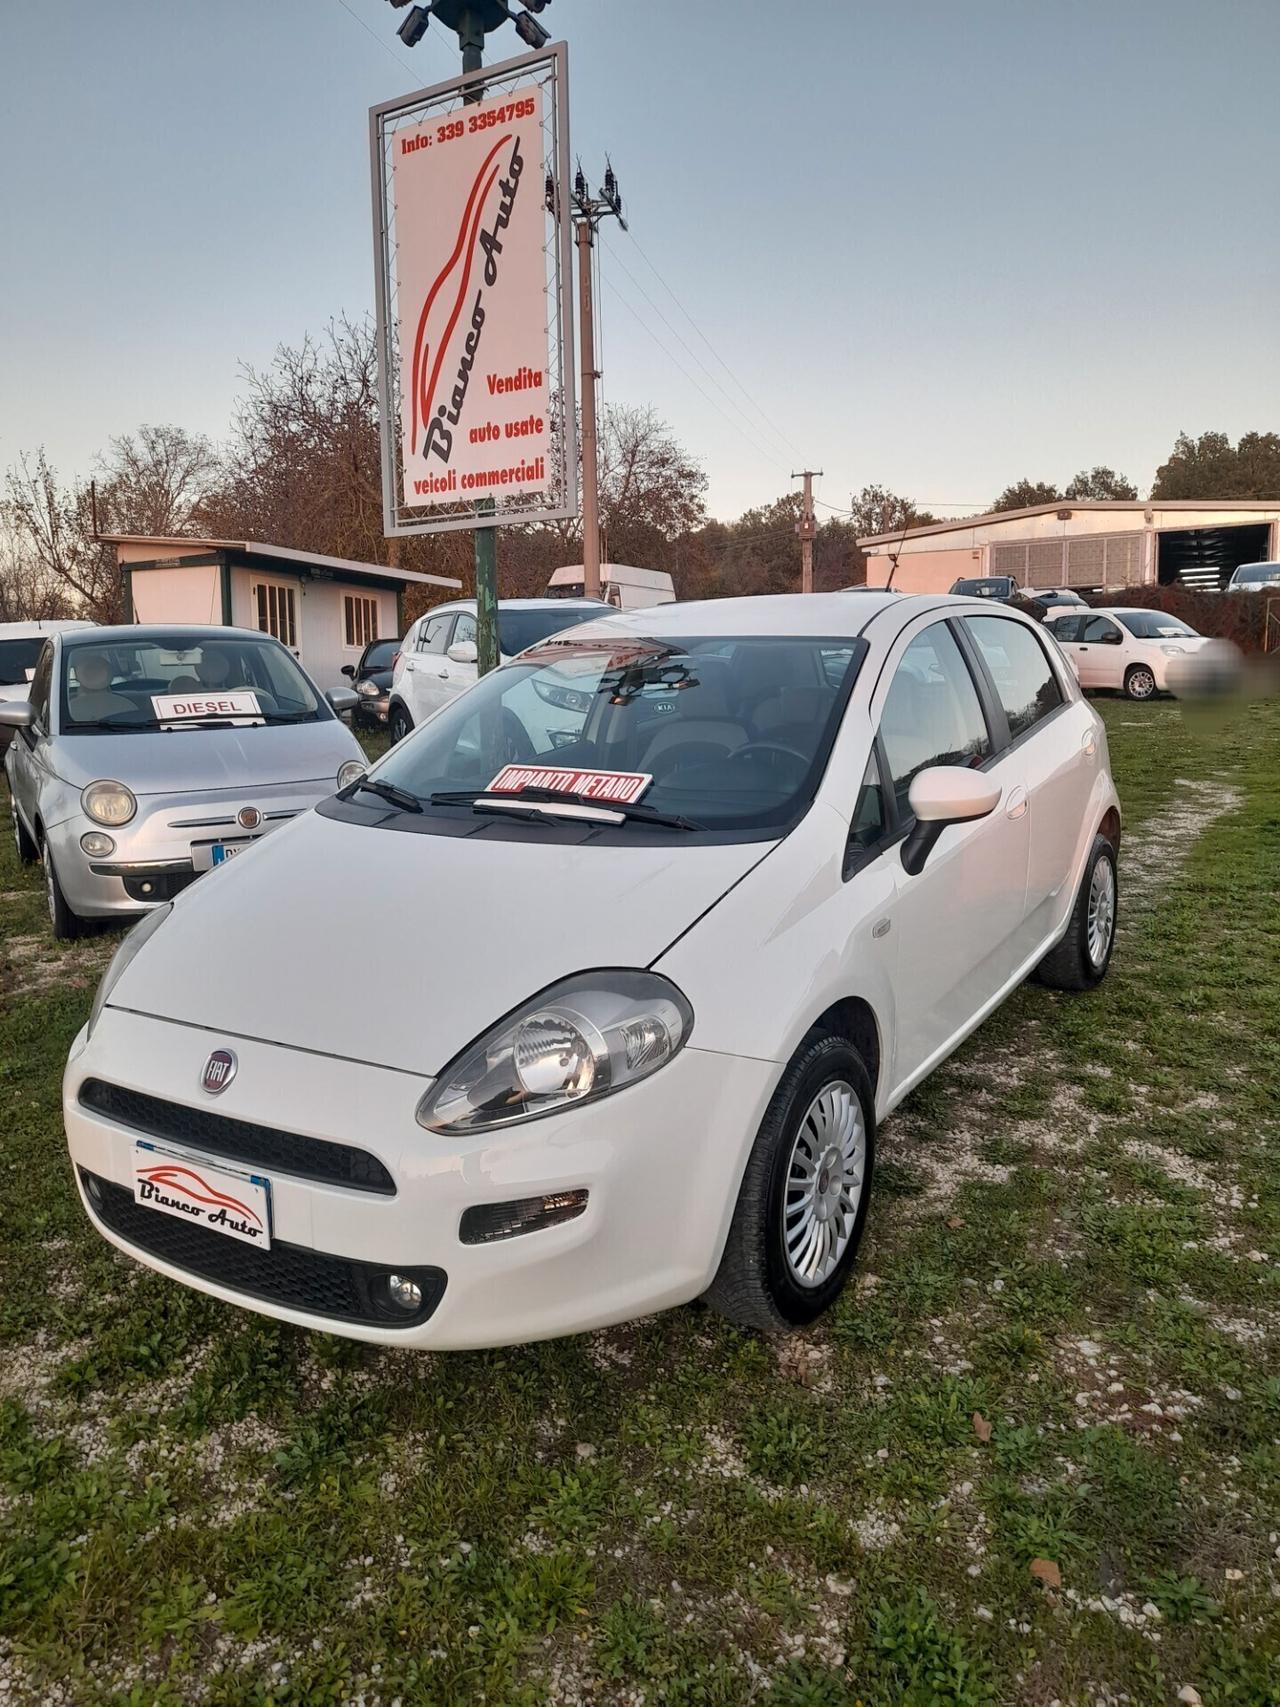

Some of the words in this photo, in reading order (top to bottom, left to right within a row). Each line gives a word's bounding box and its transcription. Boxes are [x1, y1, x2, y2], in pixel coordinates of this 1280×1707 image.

[401, 133, 433, 154] Info:
[437, 120, 464, 143] 339
[468, 98, 535, 134] 3354795
[422, 288, 486, 464] Bianco
[479, 135, 524, 287] Auto
[486, 366, 543, 395] Vendita
[469, 421, 500, 444] auto
[505, 414, 544, 438] usate
[413, 468, 457, 495] veicoli
[460, 456, 545, 489] commerciali
[172, 701, 243, 715] DIESEL
[495, 769, 575, 791] IMPIANTO
[570, 773, 641, 800] METANO
[206, 1059, 230, 1082] FIAT
[137, 1178, 206, 1217] Bianco
[207, 1208, 264, 1238] Auto
